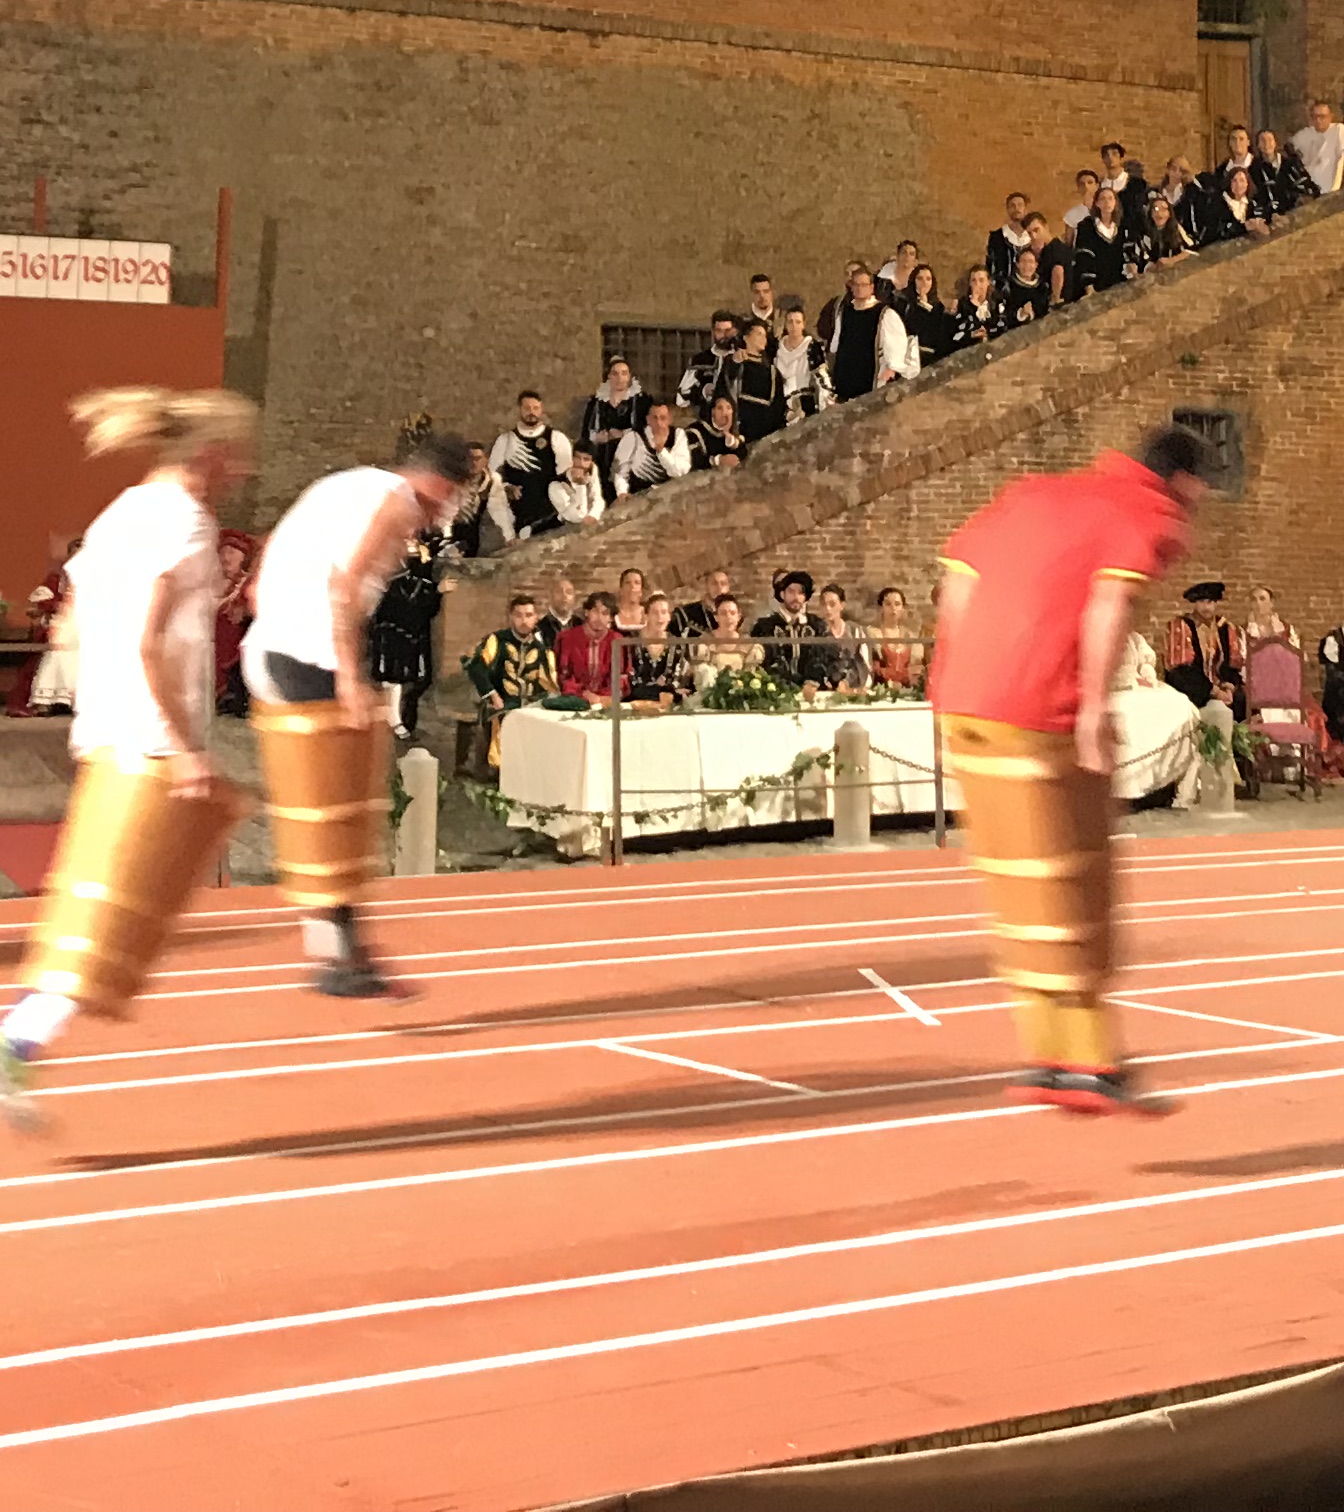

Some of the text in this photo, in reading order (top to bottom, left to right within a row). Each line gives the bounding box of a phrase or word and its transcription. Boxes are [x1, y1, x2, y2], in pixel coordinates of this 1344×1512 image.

[19, 252, 49, 281] 16
[51, 253, 80, 282] 17
[82, 255, 110, 283] 18
[112, 257, 140, 285] 19
[140, 259, 170, 287] 20
